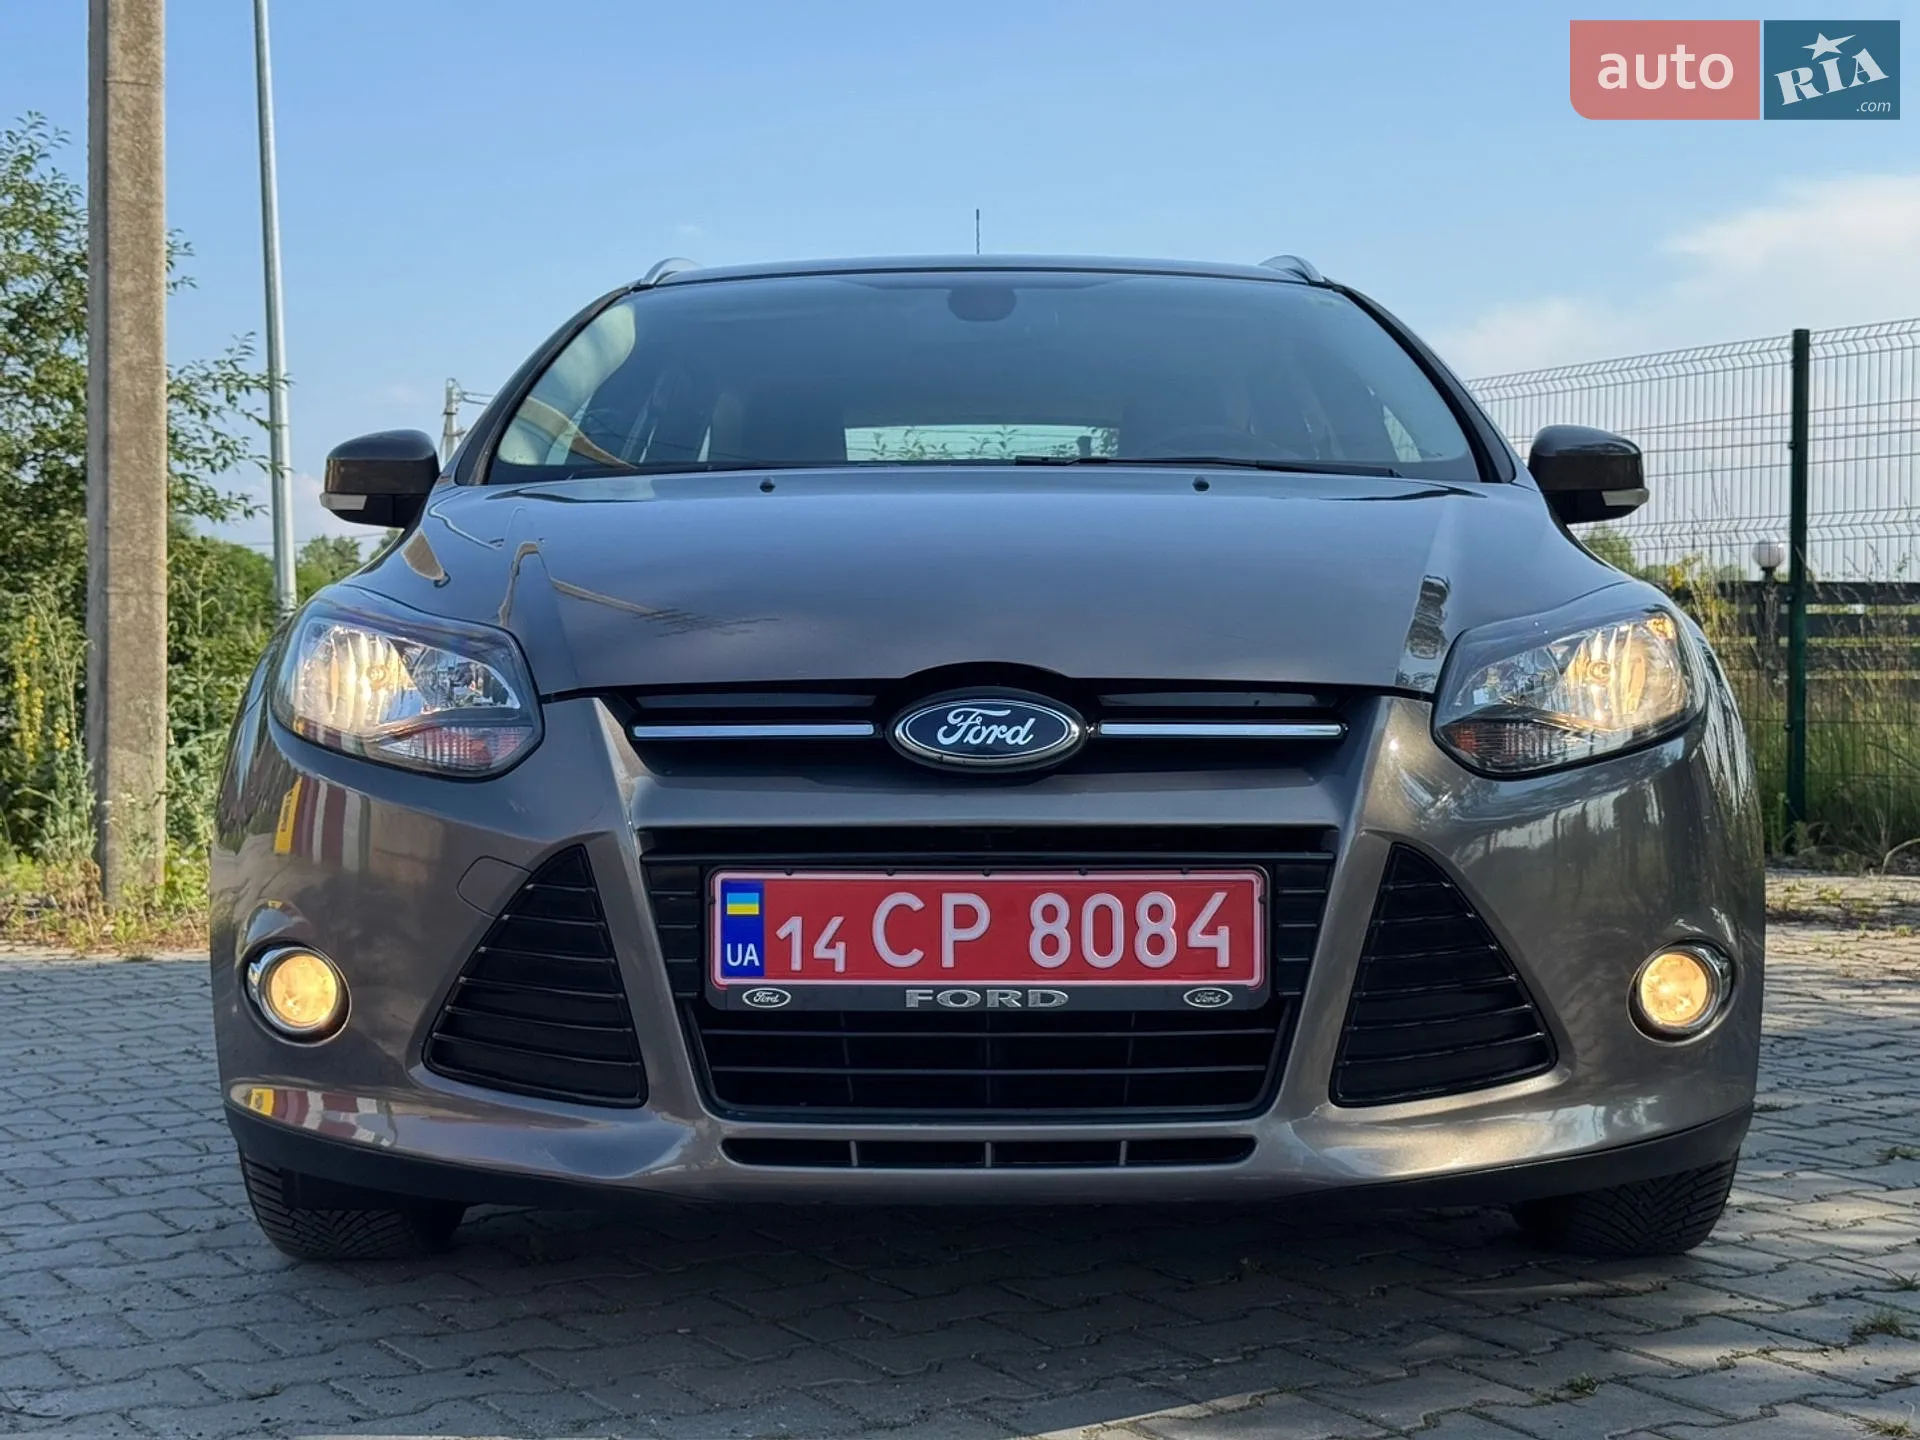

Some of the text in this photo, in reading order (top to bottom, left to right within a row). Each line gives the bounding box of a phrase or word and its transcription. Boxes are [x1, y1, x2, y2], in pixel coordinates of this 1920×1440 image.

[936, 707, 1036, 746] Ford
[775, 890, 1231, 973] 14 CP 8084
[726, 943, 760, 967] UA
[905, 989, 1069, 1008] FORD
